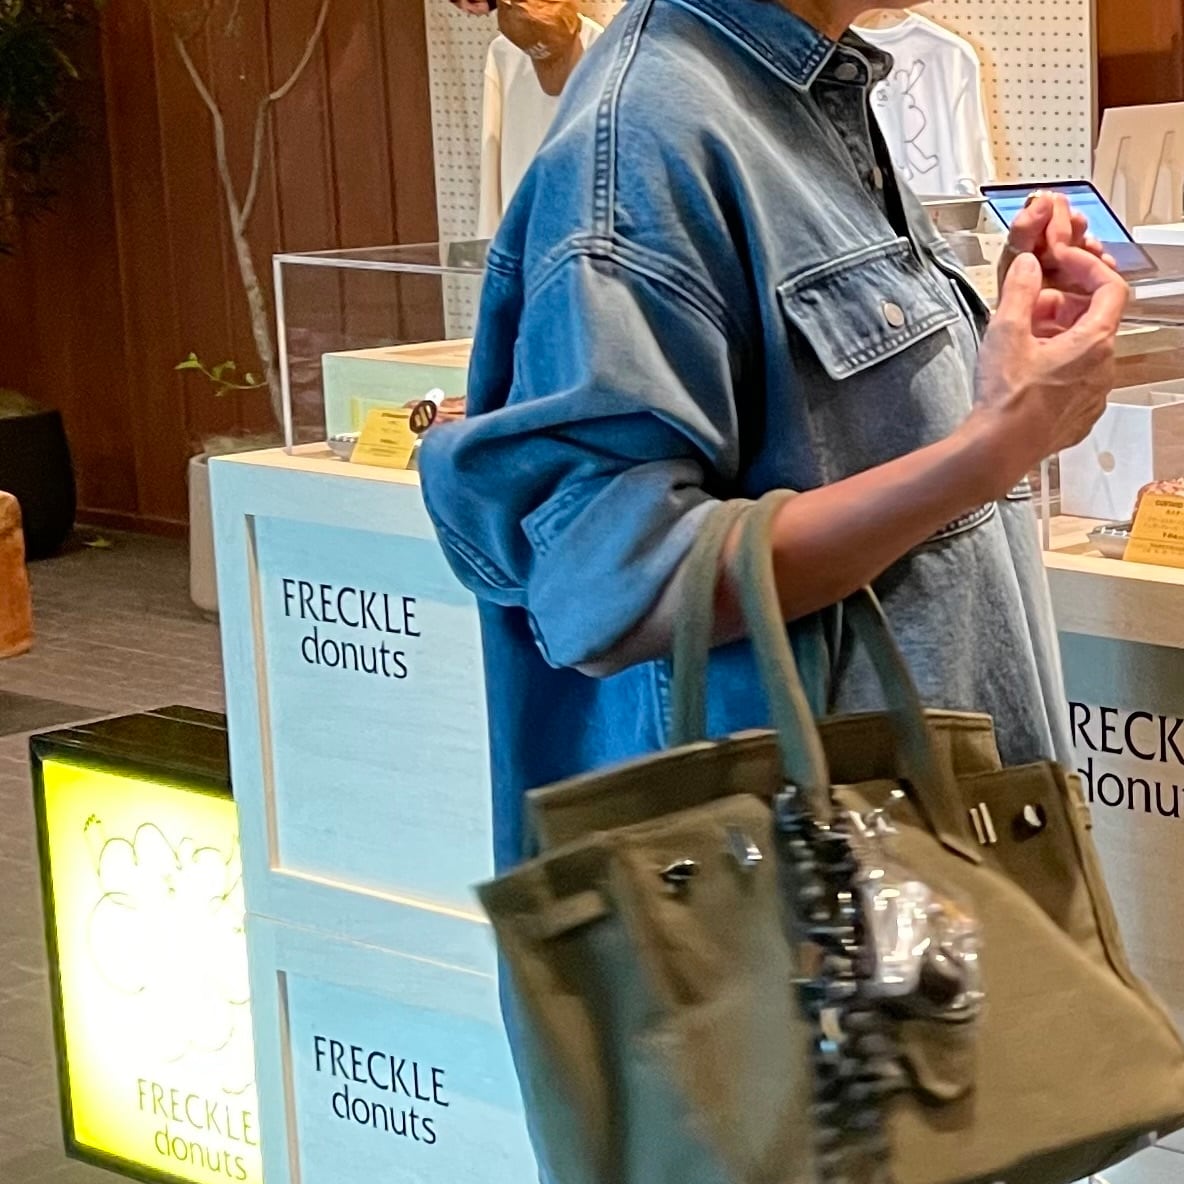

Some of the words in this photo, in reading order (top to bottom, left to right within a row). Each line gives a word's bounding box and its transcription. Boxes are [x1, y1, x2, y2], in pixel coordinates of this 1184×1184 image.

[282, 578, 421, 637] FRECKLE
[301, 625, 408, 679] donuts
[314, 1035, 449, 1107] FRECKLE
[137, 1078, 257, 1146] FRECKLE
[332, 1084, 436, 1145] donuts
[154, 1122, 247, 1181] donuts
